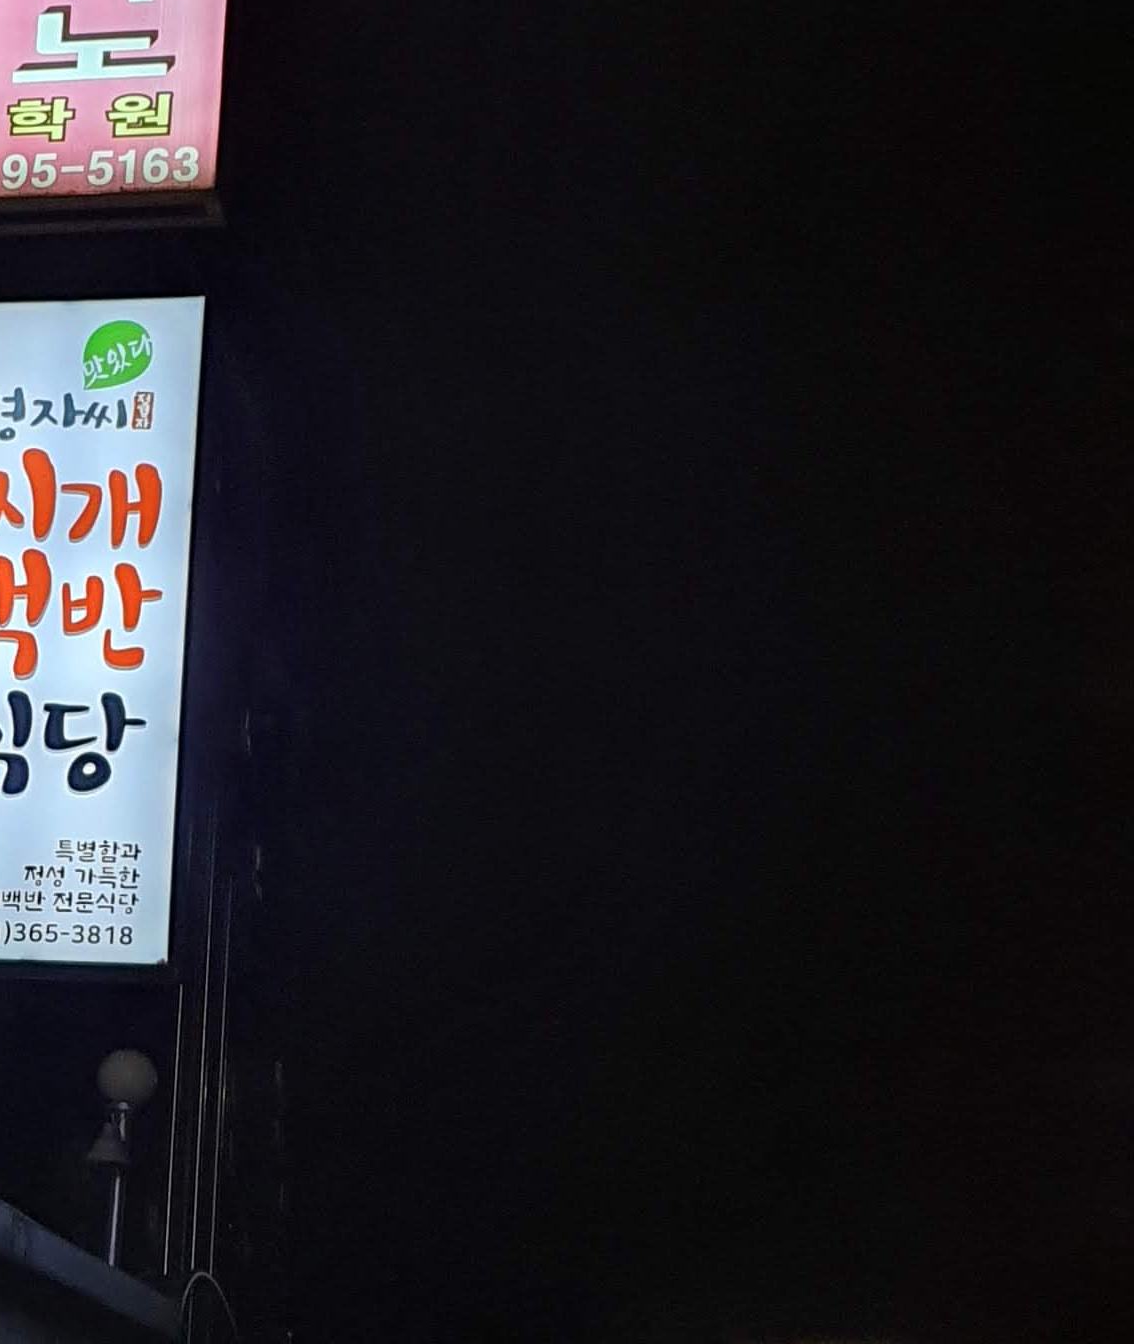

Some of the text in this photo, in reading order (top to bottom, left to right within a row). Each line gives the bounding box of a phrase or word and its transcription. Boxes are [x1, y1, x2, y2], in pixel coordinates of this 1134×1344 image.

[54, 839, 142, 863] 특별함과
[24, 864, 141, 890] 정성 가득한
[52, 890, 140, 915] 전문식당
